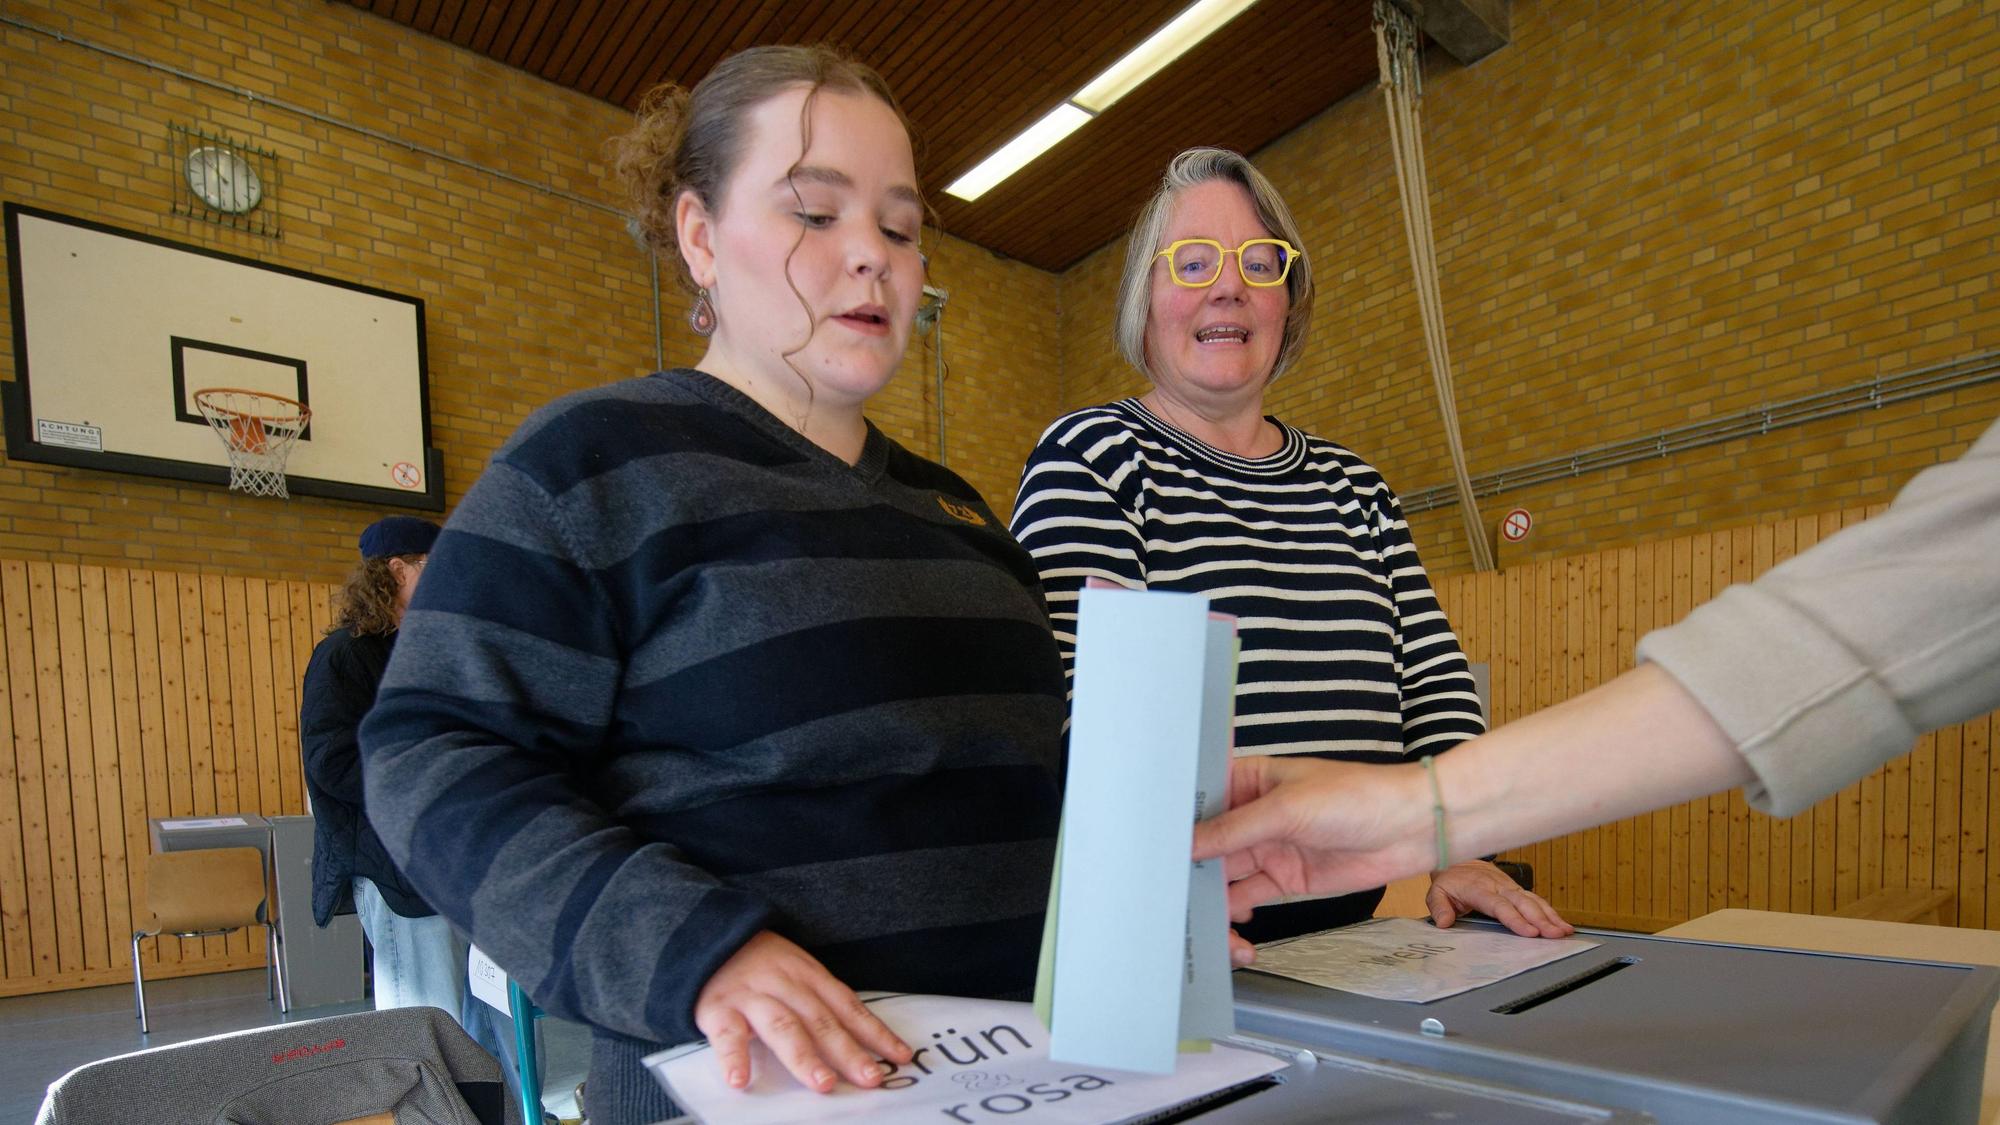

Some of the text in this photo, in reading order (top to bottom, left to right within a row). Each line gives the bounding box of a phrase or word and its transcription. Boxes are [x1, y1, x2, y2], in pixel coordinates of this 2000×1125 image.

[41, 422, 100, 435] ACHTUNG!
[876, 1023, 1032, 1089] grün
[942, 1074, 1114, 1125] rosa
